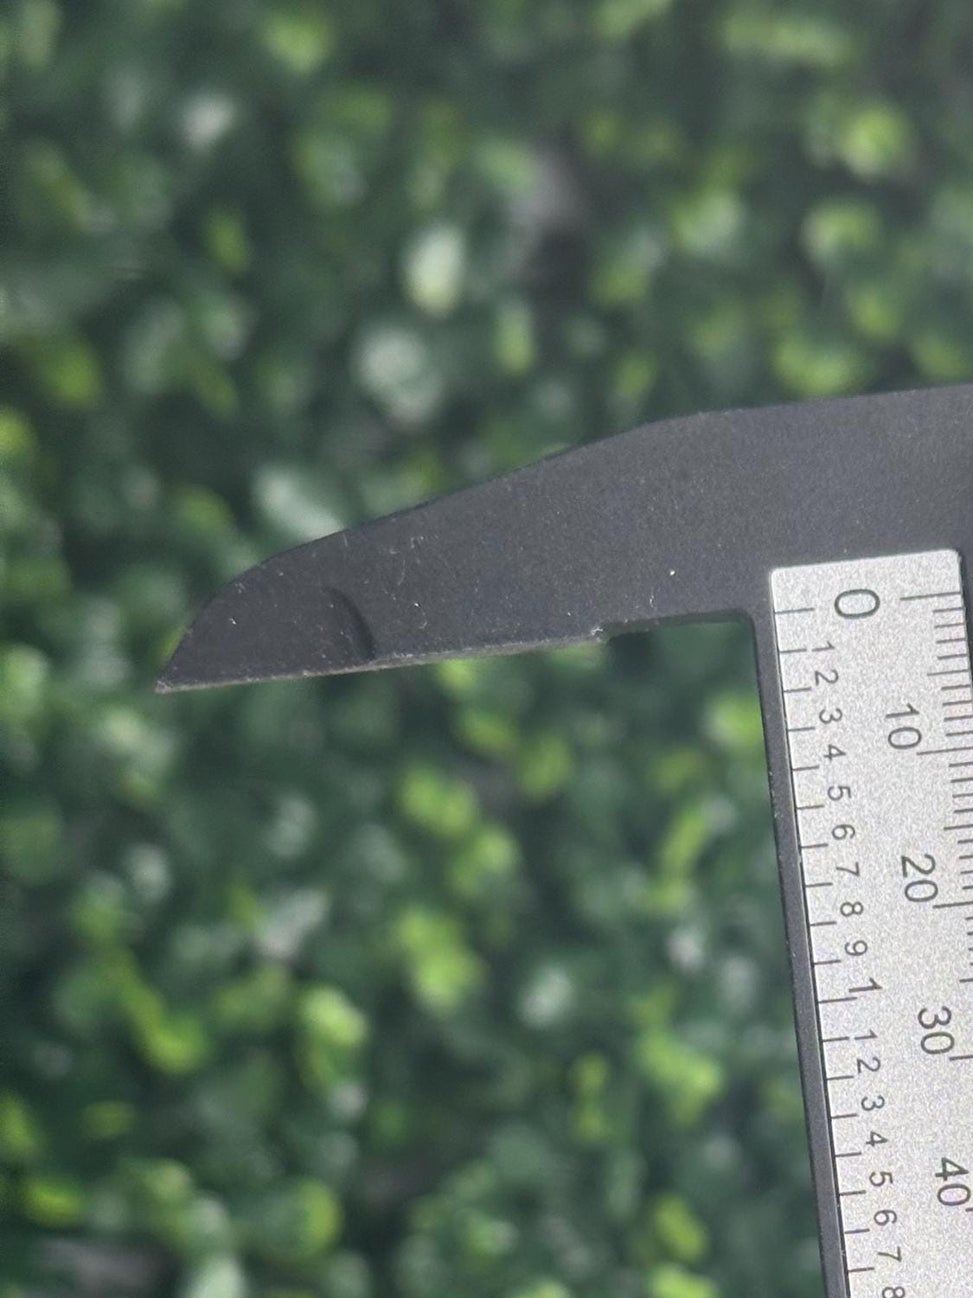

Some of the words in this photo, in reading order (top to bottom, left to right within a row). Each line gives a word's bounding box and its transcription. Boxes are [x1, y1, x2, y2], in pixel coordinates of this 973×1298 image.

[834, 588, 881, 619] 0
[812, 641, 835, 651] 1
[814, 669, 839, 685] 2
[819, 707, 843, 725] 3
[885, 703, 922, 750] 10
[823, 744, 846, 761] 4
[827, 785, 851, 801] 5
[832, 824, 856, 840] 6
[836, 862, 859, 877] 7
[901, 854, 939, 903] 20
[840, 901, 864, 917] 8
[845, 940, 868, 956] 9
[848, 978, 883, 993] 1
[854, 1030, 878, 1040] 1
[917, 1006, 955, 1055] 30
[856, 1056, 881, 1074] 2
[861, 1095, 885, 1111] 3
[866, 1131, 888, 1147] 4
[869, 1171, 893, 1187] 5
[935, 1157, 971, 1206] 40
[873, 1209, 897, 1226] 6
[877, 1246, 901, 1262] 7
